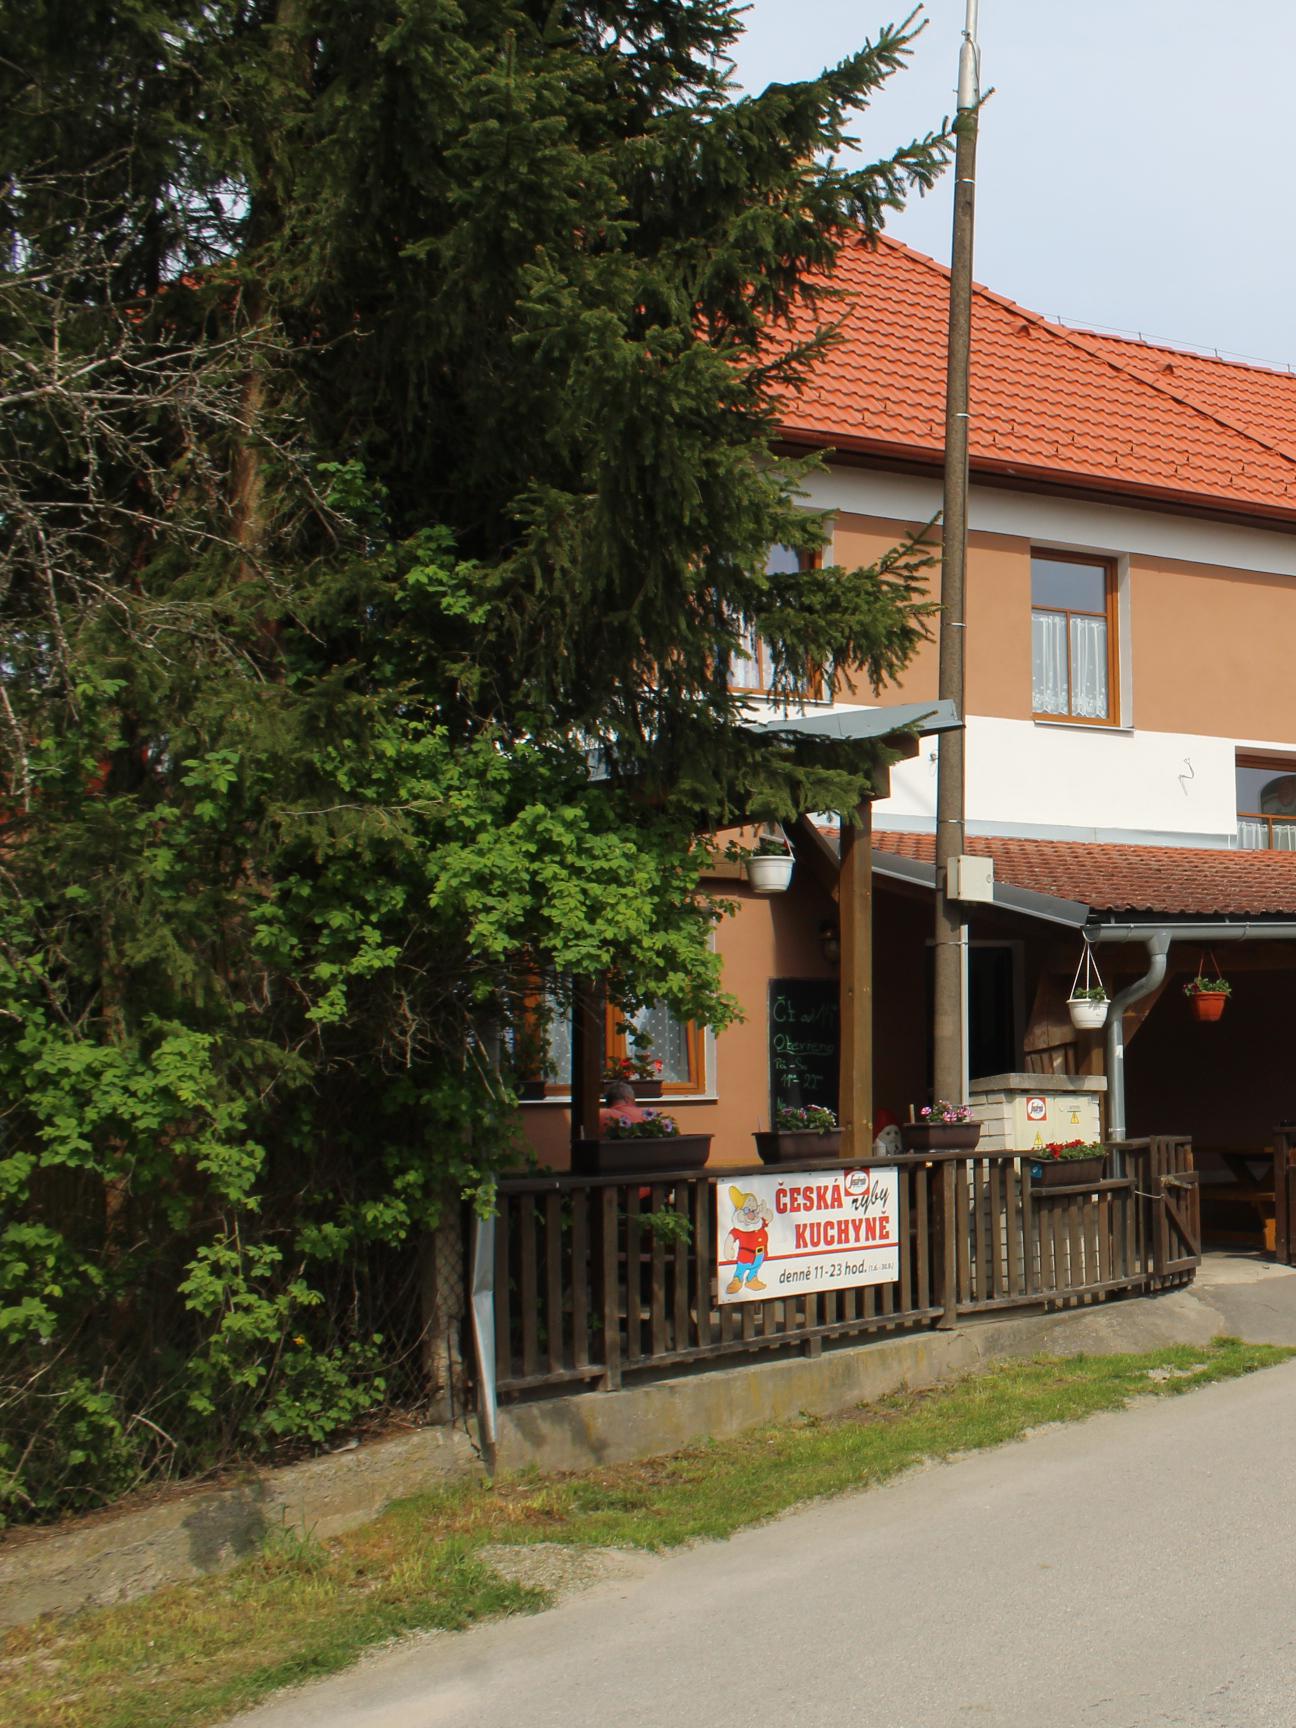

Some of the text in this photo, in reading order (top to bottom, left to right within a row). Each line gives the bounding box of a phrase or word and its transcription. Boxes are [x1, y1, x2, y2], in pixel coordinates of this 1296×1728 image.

[775, 1178, 843, 1214] ČESKÁ
[851, 1179, 890, 1215] ryby
[795, 1211, 890, 1249] KUCHYNĚ
[778, 1267, 811, 1284] denně
[814, 1264, 842, 1280] 11-23
[844, 1259, 868, 1276] hod.
